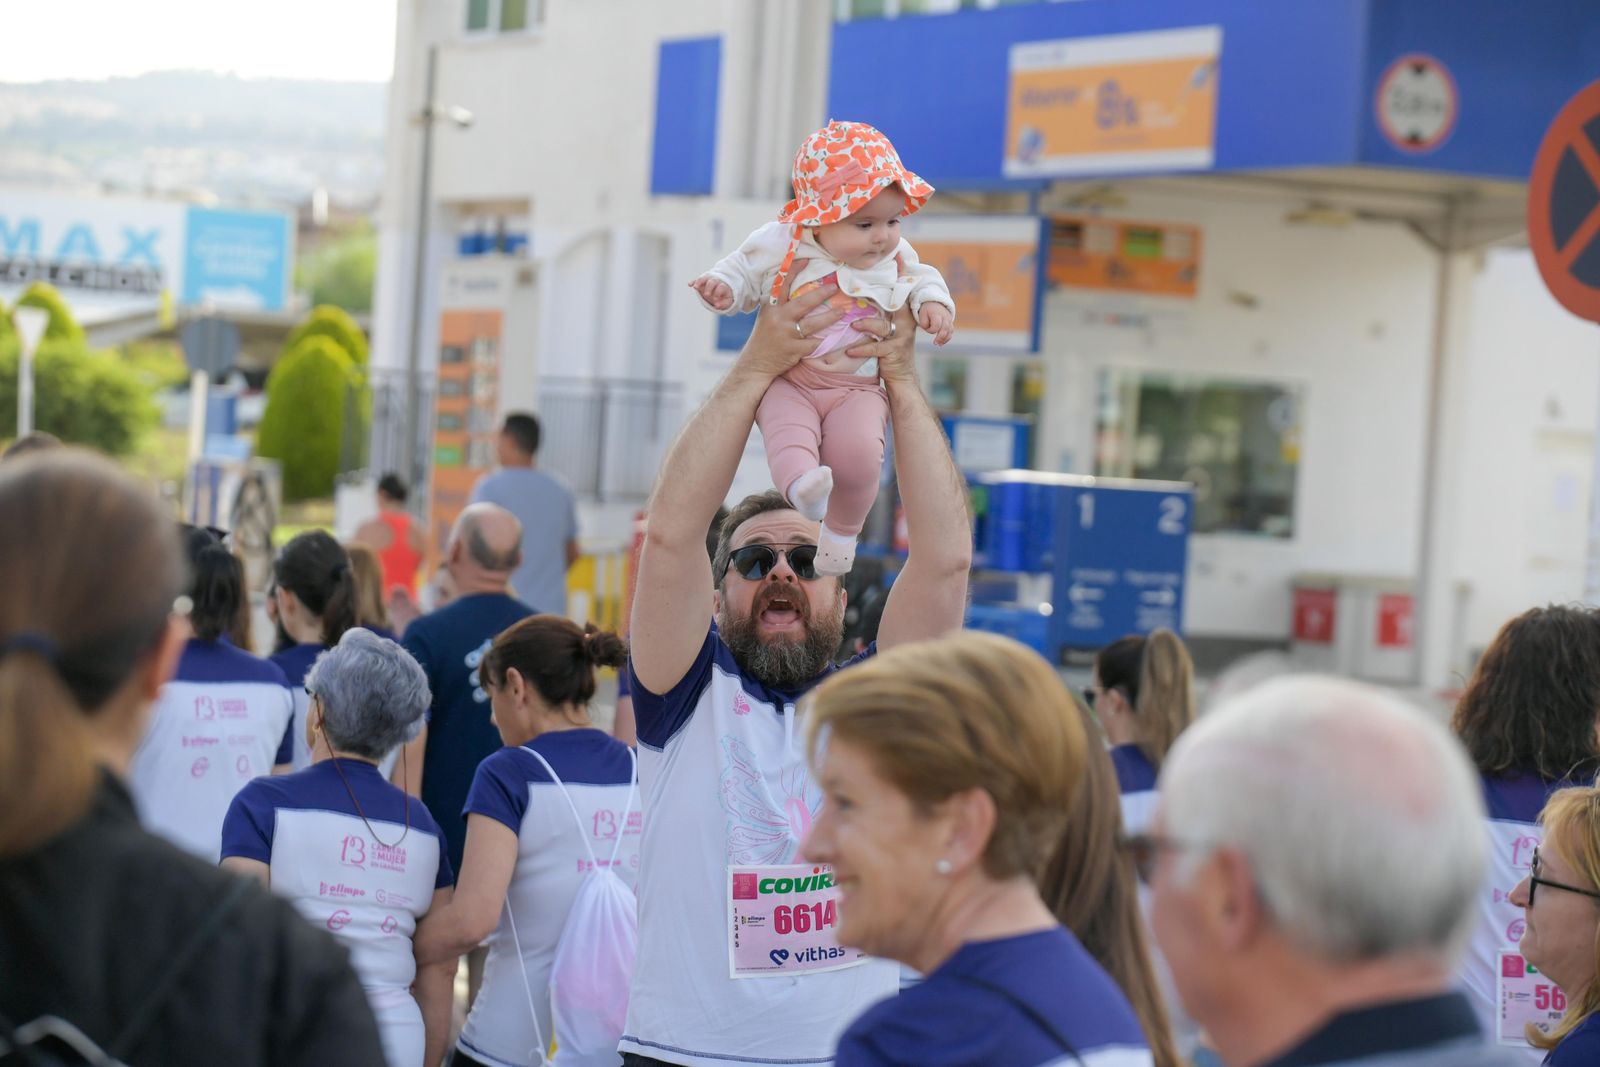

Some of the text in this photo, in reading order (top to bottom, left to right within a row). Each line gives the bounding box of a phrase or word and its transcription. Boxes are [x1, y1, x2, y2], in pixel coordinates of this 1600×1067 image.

[1079, 493, 1095, 529] 1
[1158, 496, 1186, 534] 2
[341, 835, 366, 865] 13
[377, 851, 406, 865] MUJER
[329, 884, 366, 897] olimpo
[774, 899, 837, 935] 6614
[793, 945, 846, 963] vithas
